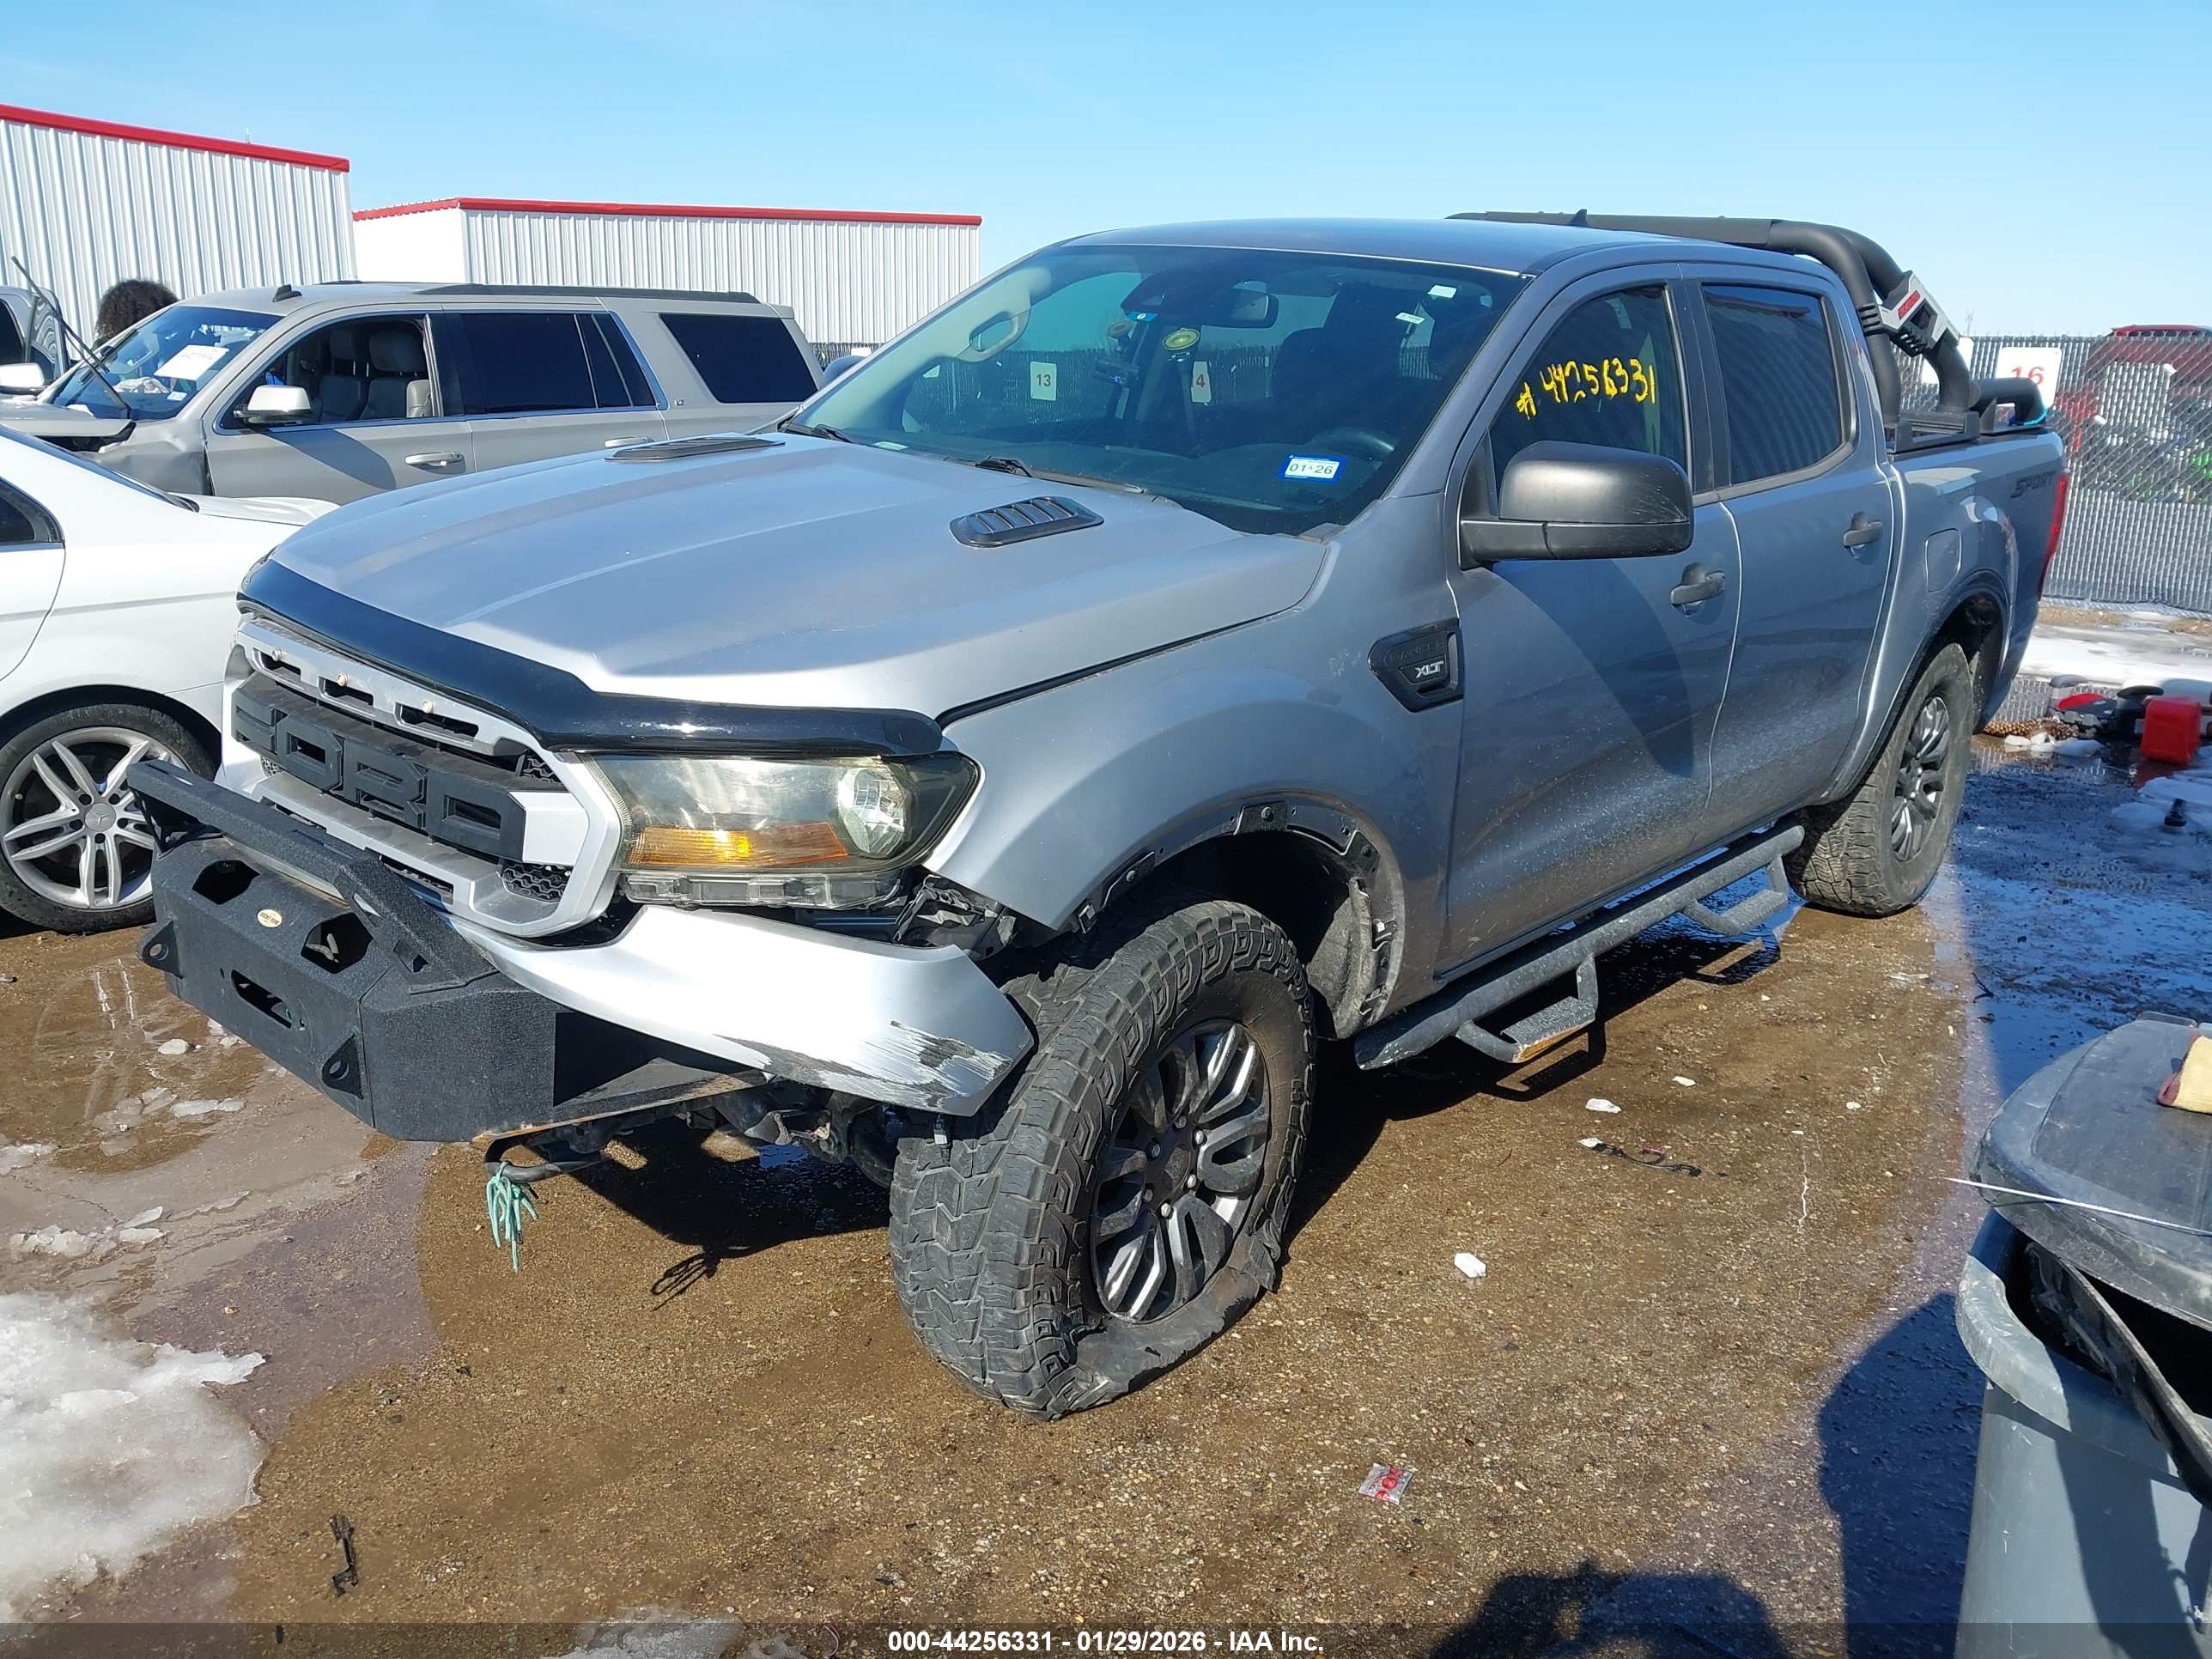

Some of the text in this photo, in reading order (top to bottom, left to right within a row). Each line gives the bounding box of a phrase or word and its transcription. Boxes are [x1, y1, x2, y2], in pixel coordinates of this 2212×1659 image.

[1036, 374, 1052, 387] 13
[2011, 366, 2045, 385] 16
[2010, 470, 2057, 499] SPORT
[1415, 660, 1444, 678] XLT
[231, 689, 527, 862] FORD
